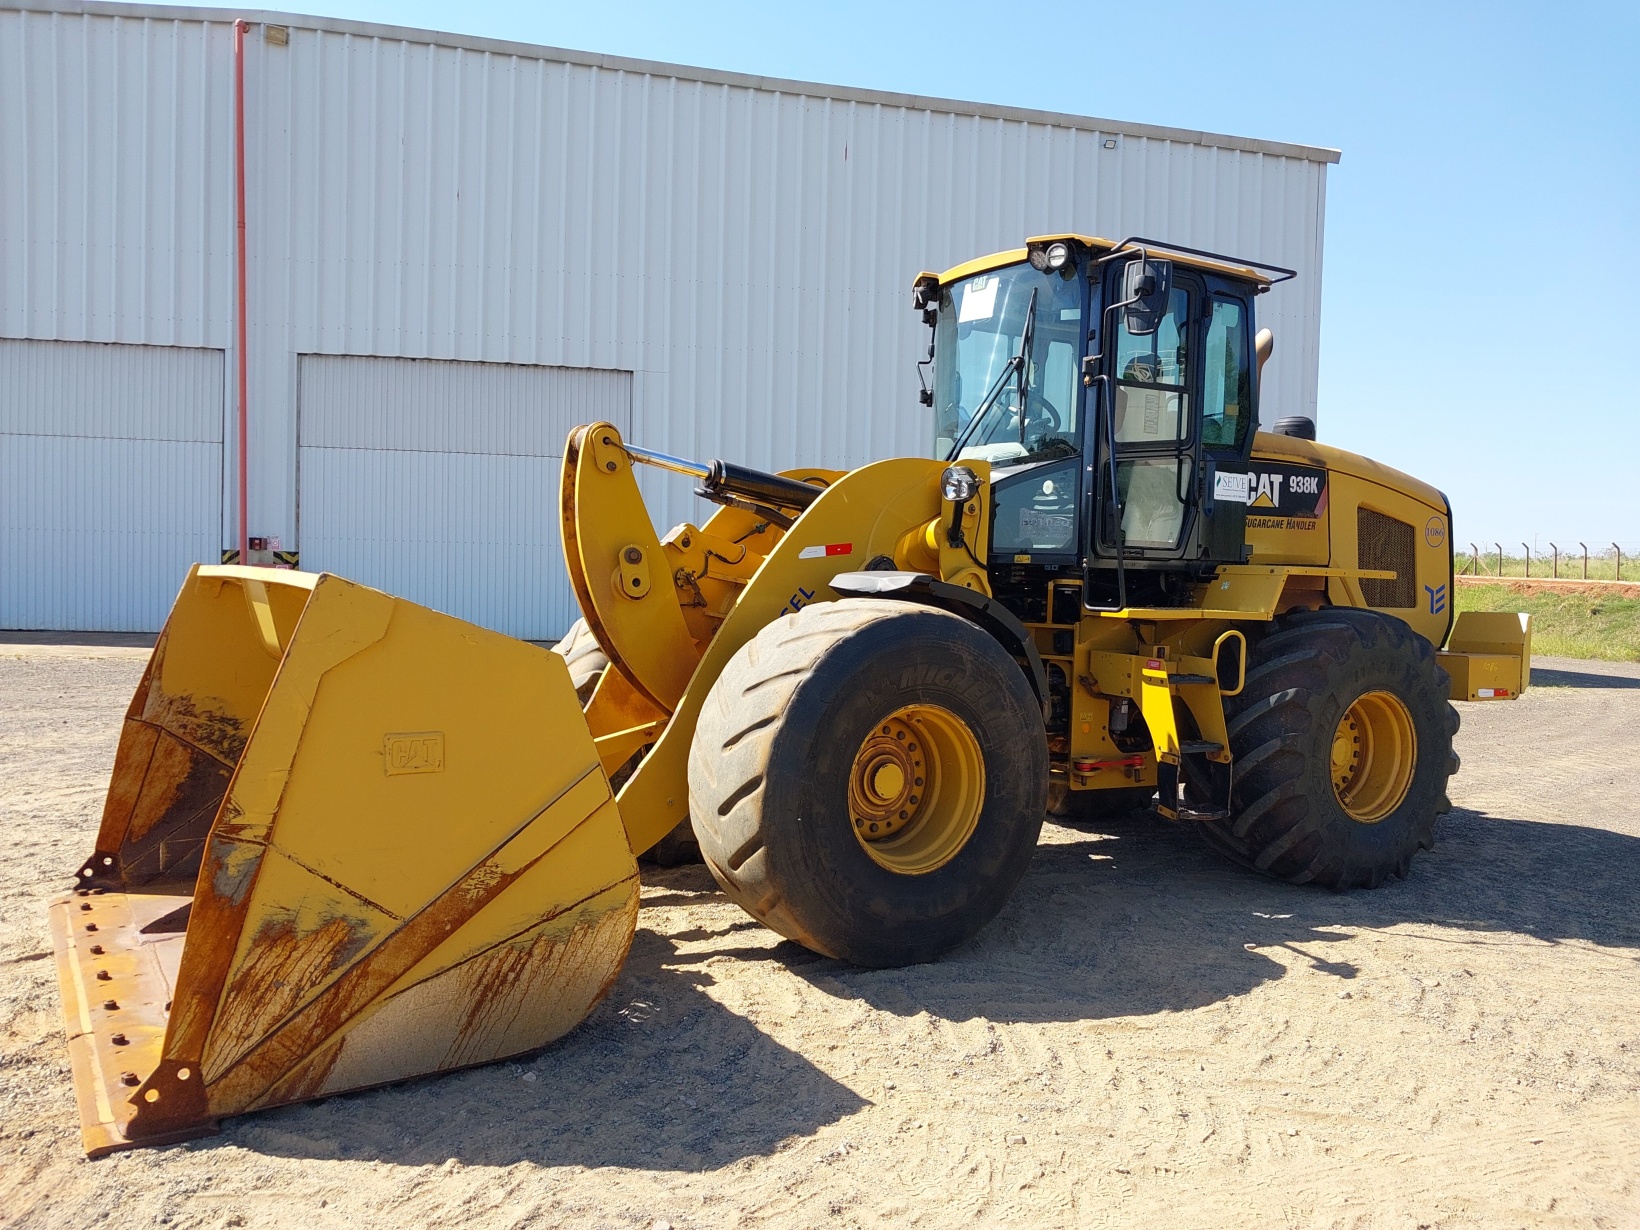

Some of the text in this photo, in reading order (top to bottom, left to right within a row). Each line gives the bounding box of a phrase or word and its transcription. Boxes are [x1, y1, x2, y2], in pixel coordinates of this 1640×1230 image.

[972, 274, 988, 291] CAT
[1246, 471, 1319, 508] CAT 938K
[1426, 527, 1444, 537] 1086
[391, 738, 439, 769] CAT
